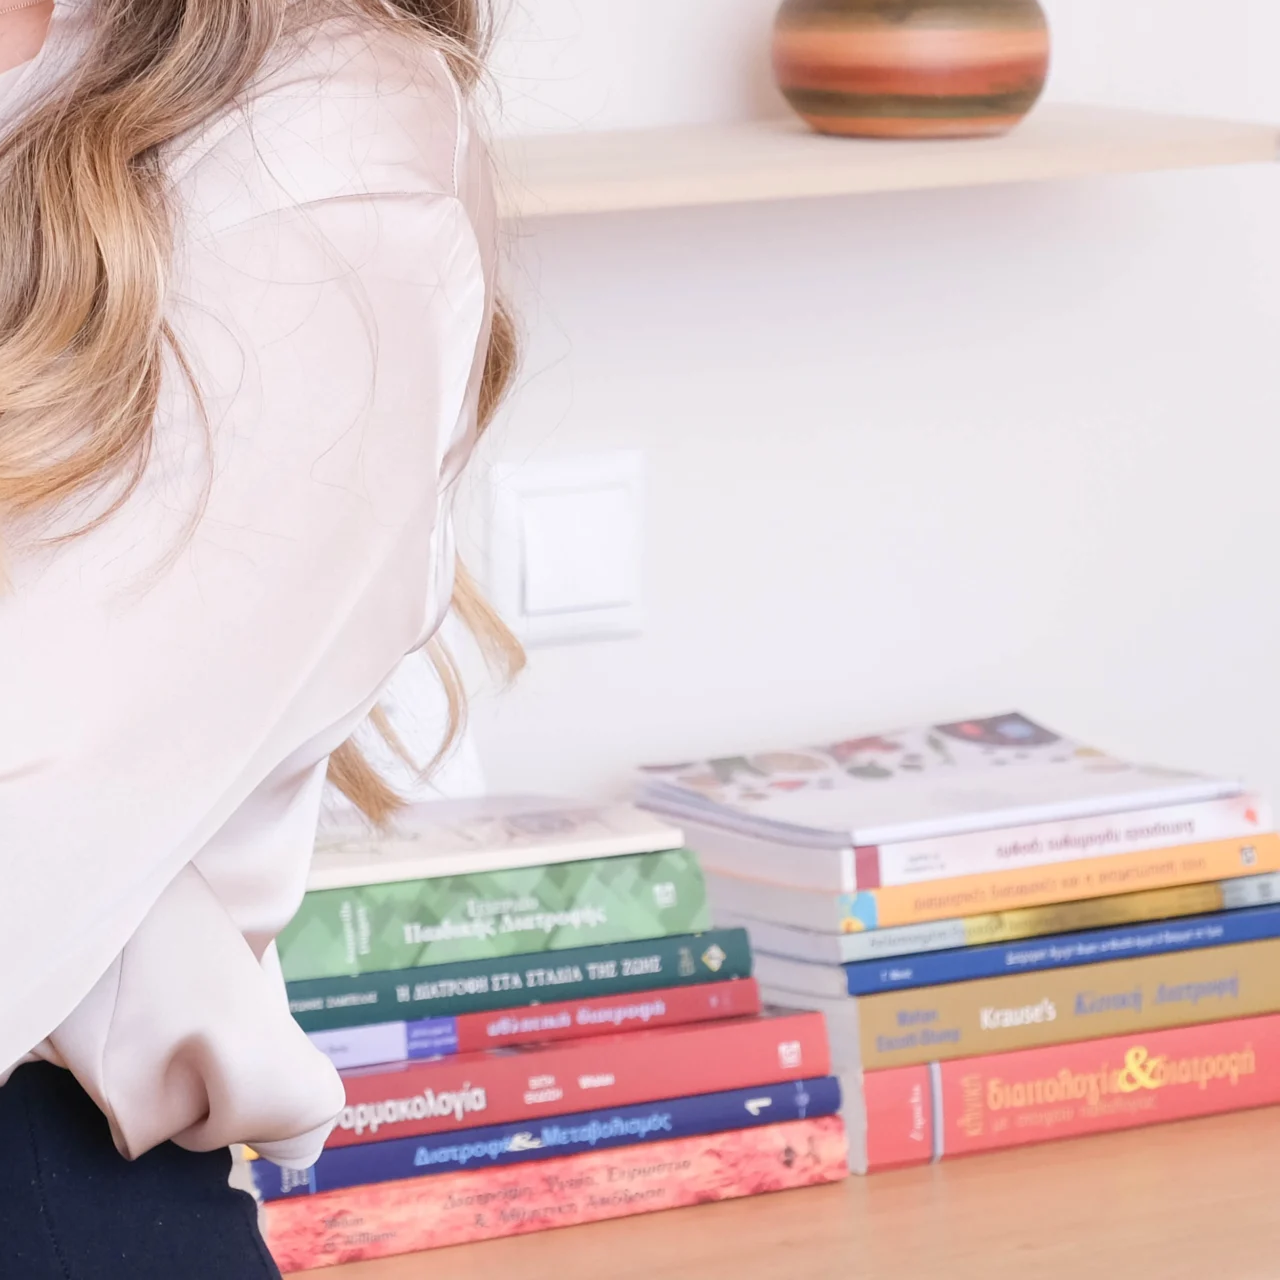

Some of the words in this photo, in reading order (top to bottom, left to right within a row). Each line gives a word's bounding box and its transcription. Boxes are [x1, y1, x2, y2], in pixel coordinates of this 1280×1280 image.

[396, 984, 411, 1003] Η
[413, 975, 489, 1001] ΔΙΑΤΡΟΦΗ
[491, 973, 522, 991] ΣΤΑ
[526, 965, 582, 988] ΣΤΑΔΙΑ
[586, 962, 618, 980] ΤΗΣ
[622, 955, 663, 976] ΖΩΗΣ
[979, 997, 1058, 1031] Krause's
[1116, 1045, 1166, 1093] &
[335, 1081, 487, 1135] αρμακολογία
[541, 1112, 673, 1147] Μεταβολισμός
